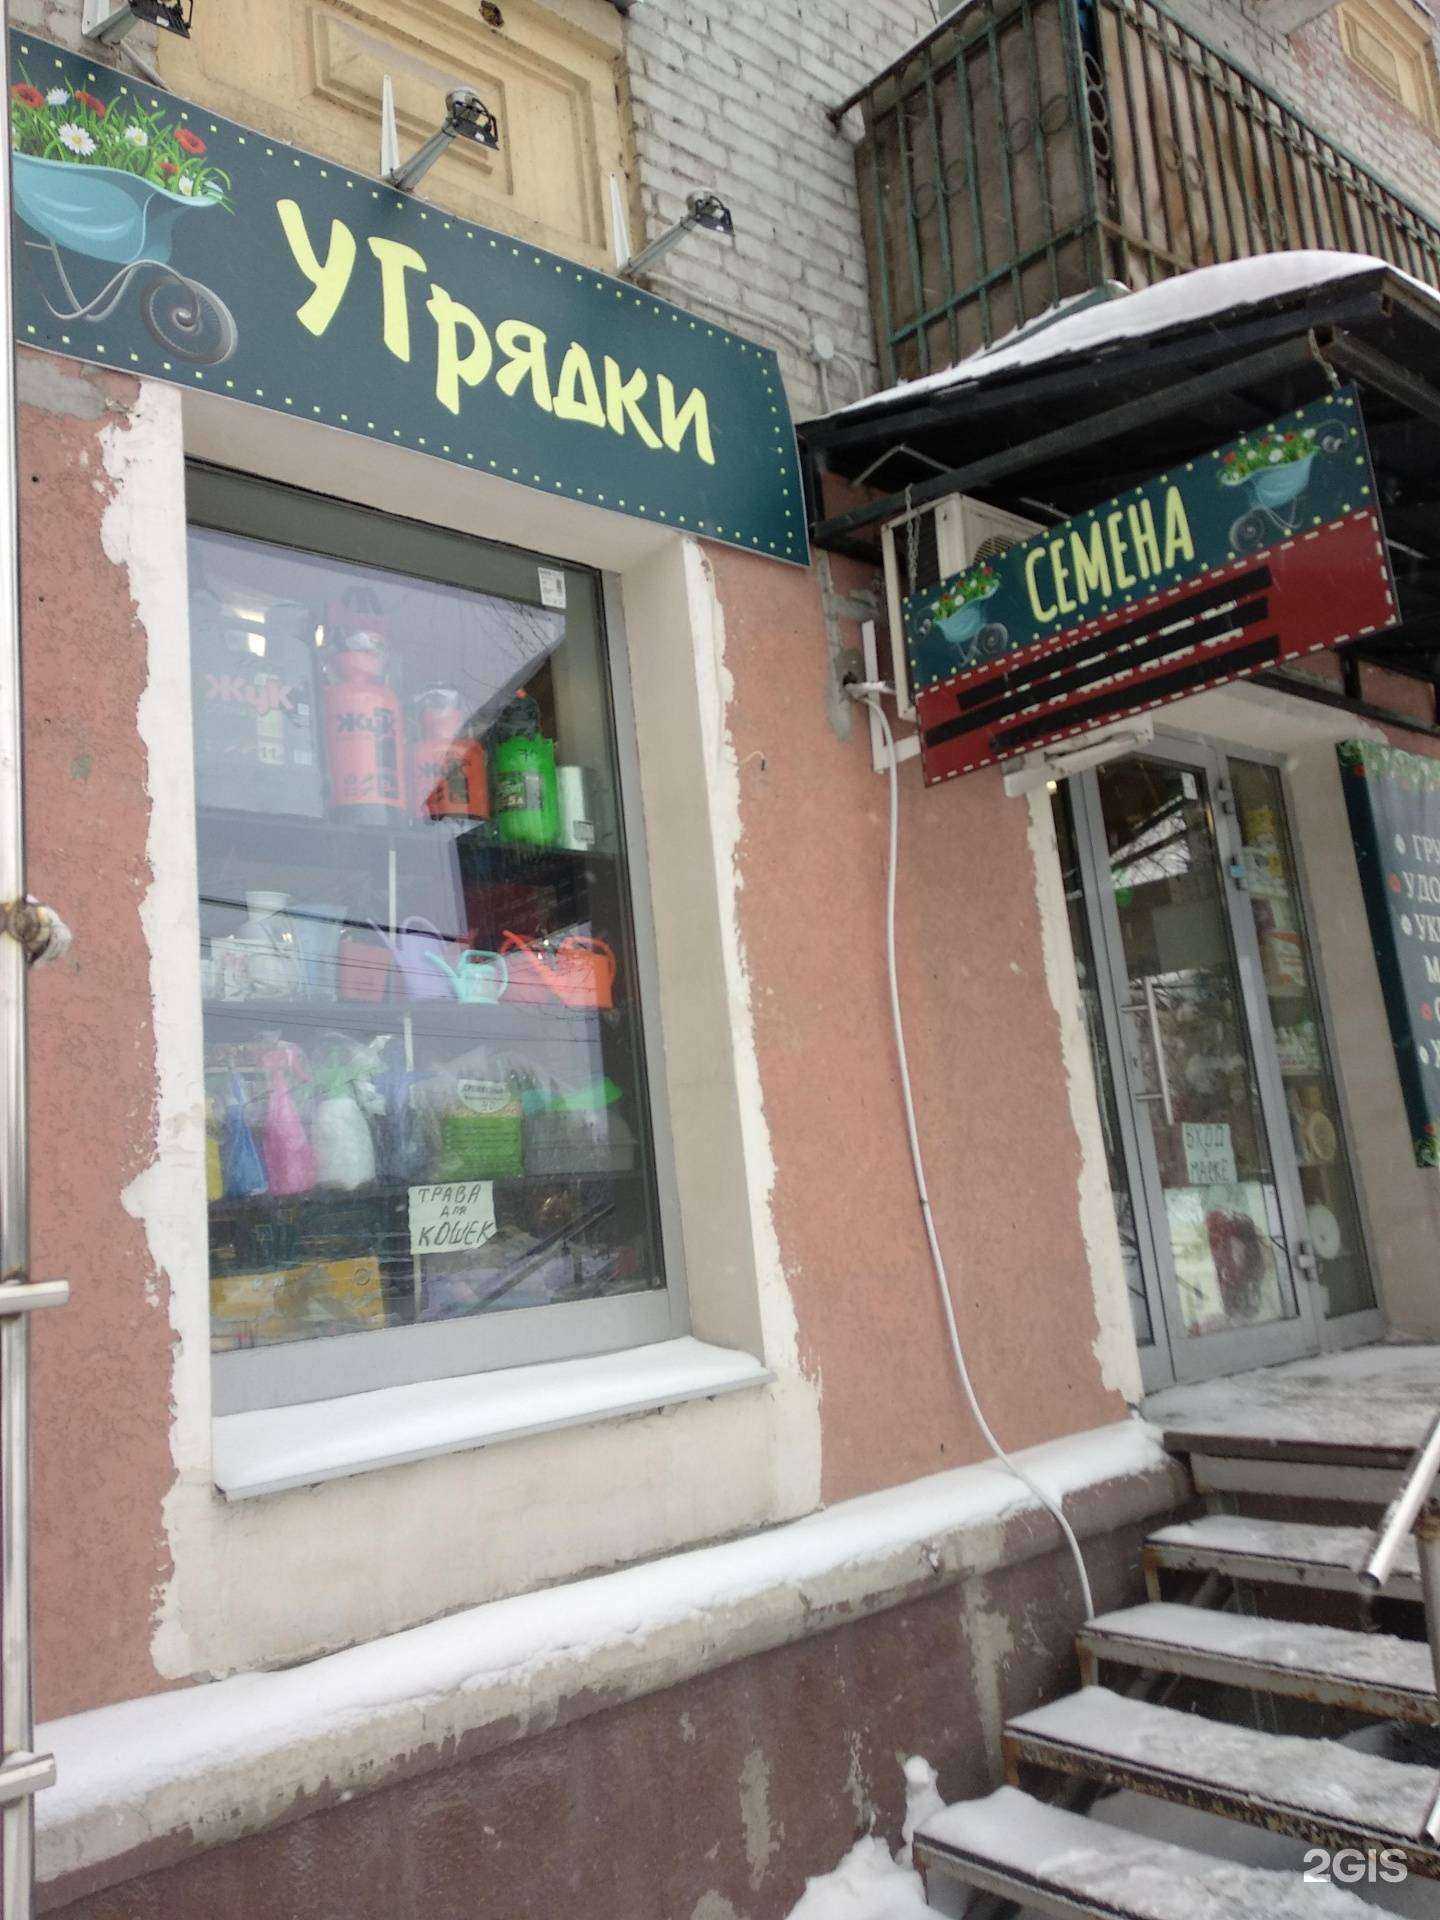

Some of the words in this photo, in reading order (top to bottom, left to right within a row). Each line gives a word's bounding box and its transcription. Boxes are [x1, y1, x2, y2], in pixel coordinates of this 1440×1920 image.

[1025, 486, 1195, 623] СЕМЕНА
[418, 1183, 482, 1204] ТРАВА
[418, 1220, 495, 1247] КОШЕК
